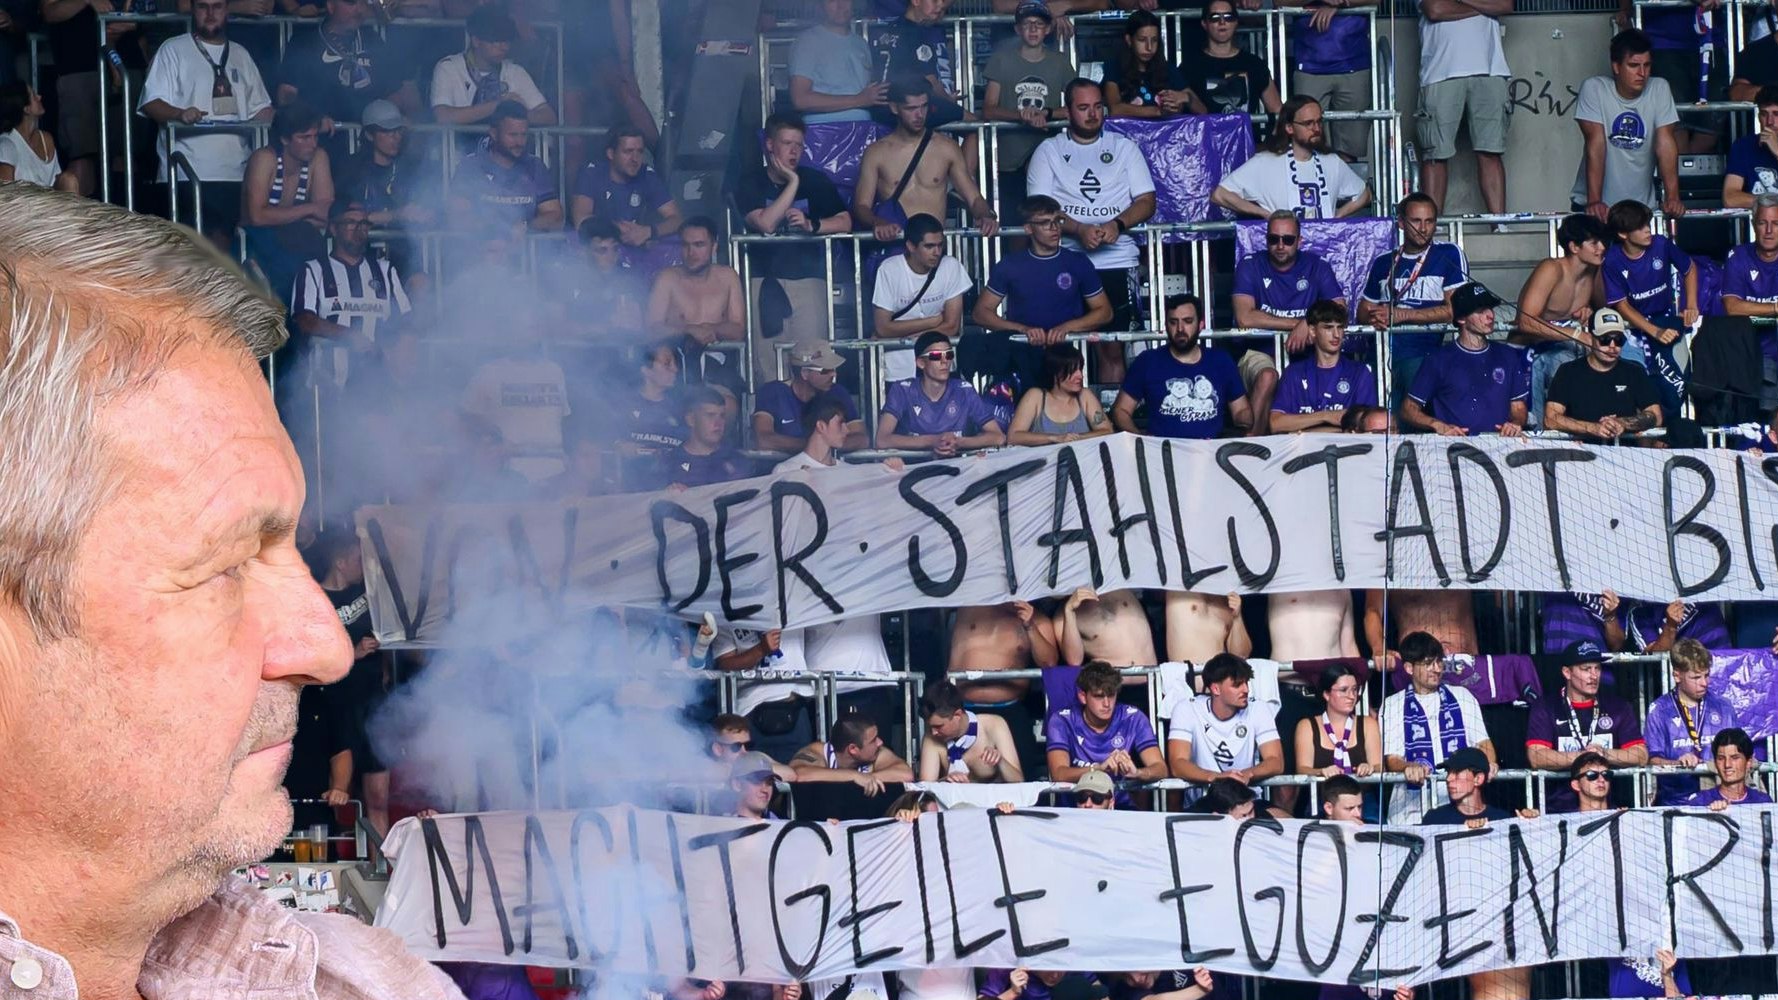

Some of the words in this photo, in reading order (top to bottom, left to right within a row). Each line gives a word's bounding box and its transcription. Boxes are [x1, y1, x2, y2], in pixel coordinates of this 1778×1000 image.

[1063, 203, 1122, 217] STEELCOIN
[649, 480, 845, 626] DER
[898, 438, 1598, 598] STAHLSTADT
[421, 807, 1070, 983] MACHTGEILE
